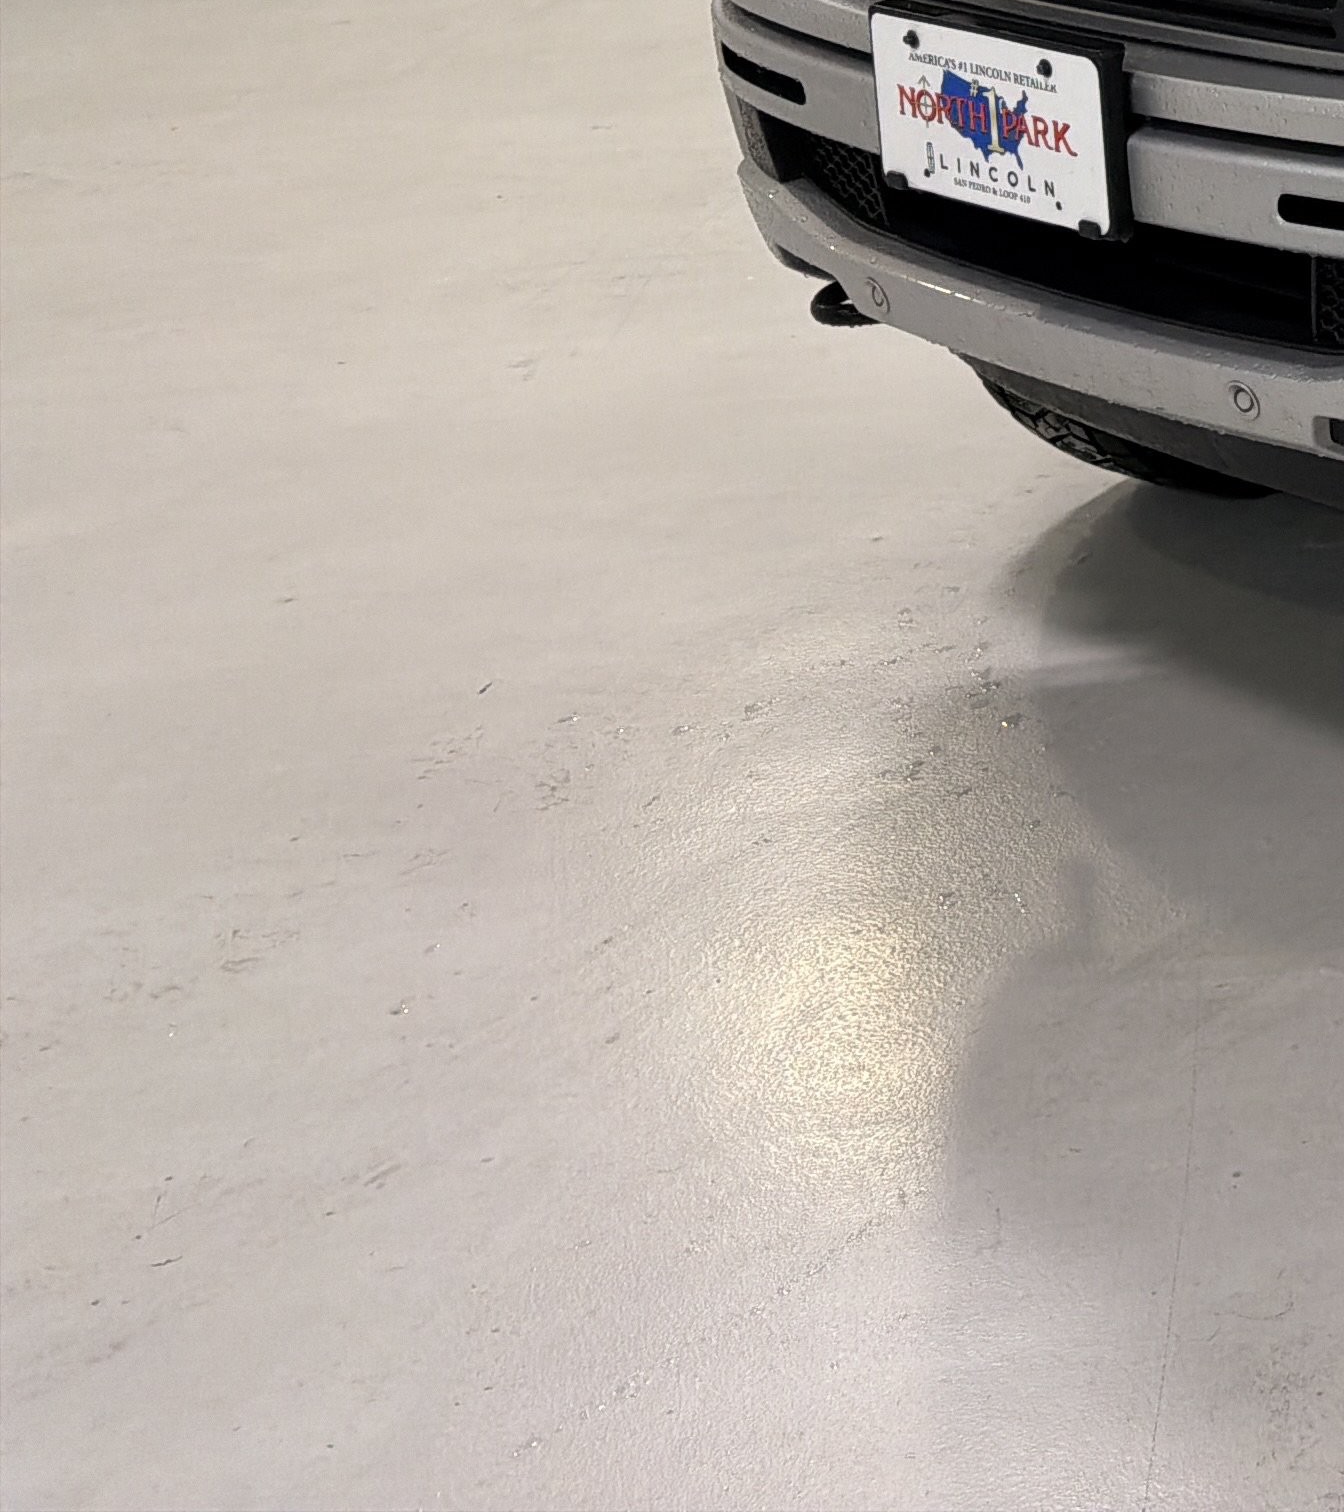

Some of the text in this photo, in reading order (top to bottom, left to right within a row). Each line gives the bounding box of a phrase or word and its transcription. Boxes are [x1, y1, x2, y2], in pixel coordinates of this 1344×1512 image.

[909, 53, 1057, 93] AMERICA'S #1 LINCOLN RETAILER
[896, 84, 1078, 157] NORTH PARK
[940, 153, 1055, 198] LINCOLN
[954, 177, 967, 187] SAN
[999, 188, 1019, 201] LOOP
